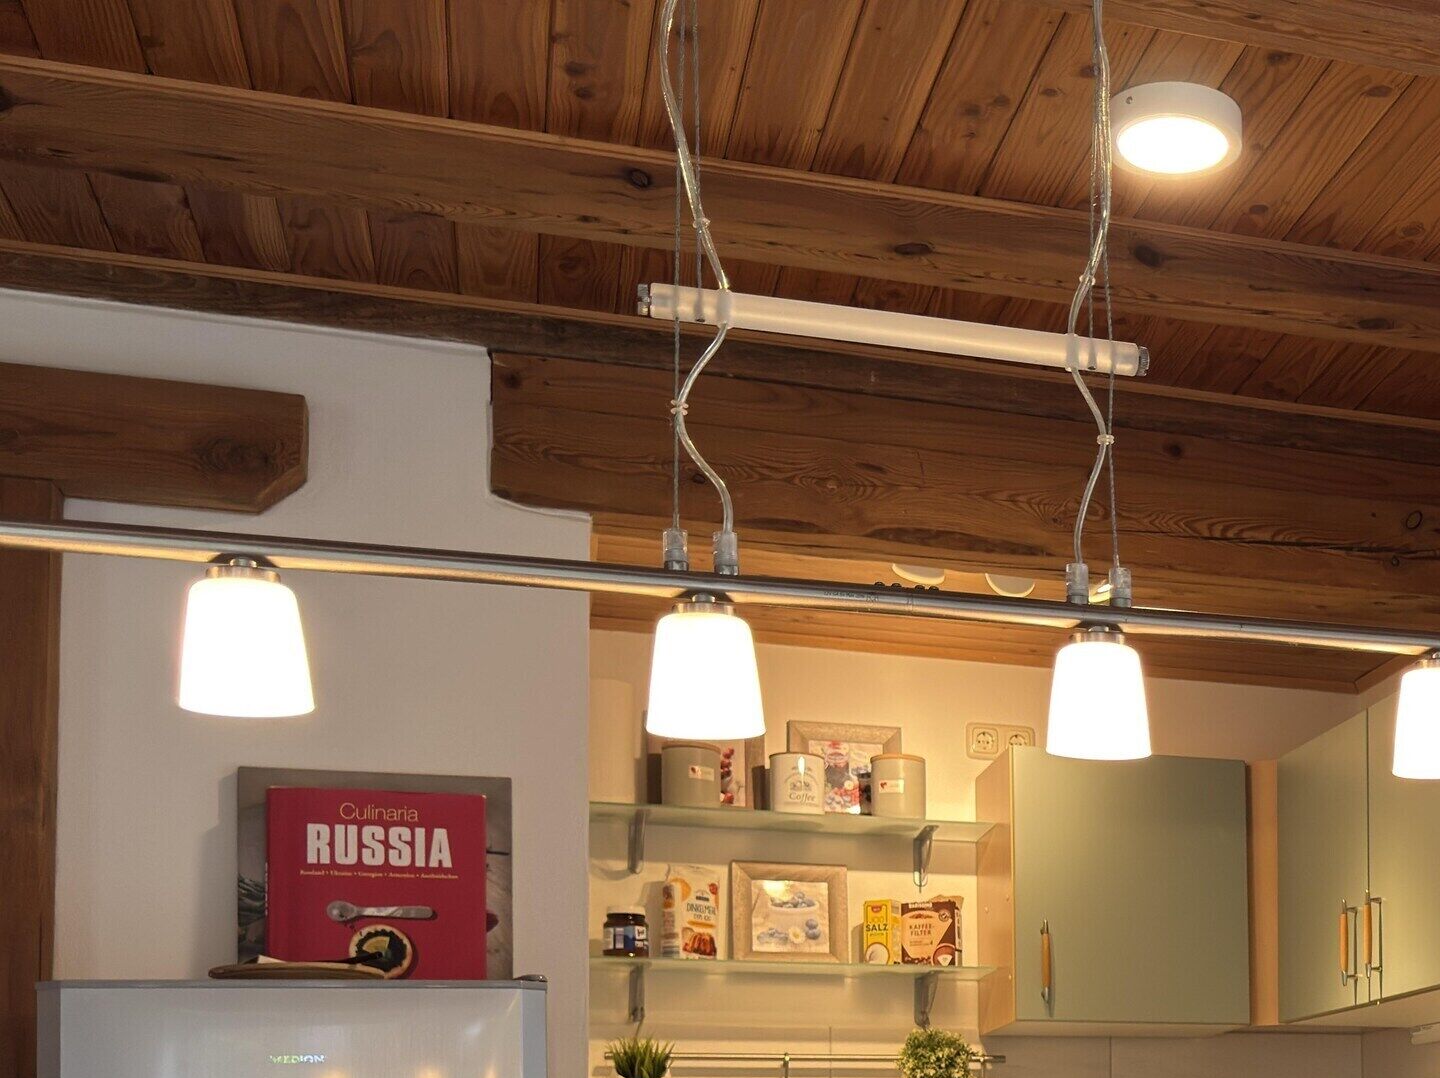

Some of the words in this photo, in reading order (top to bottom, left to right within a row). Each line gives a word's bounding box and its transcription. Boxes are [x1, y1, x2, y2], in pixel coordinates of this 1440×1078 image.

[788, 792, 817, 805] Coffee
[340, 802, 419, 822] Culinaria
[306, 823, 453, 868] RUSSIA
[865, 923, 888, 932] SALZ
